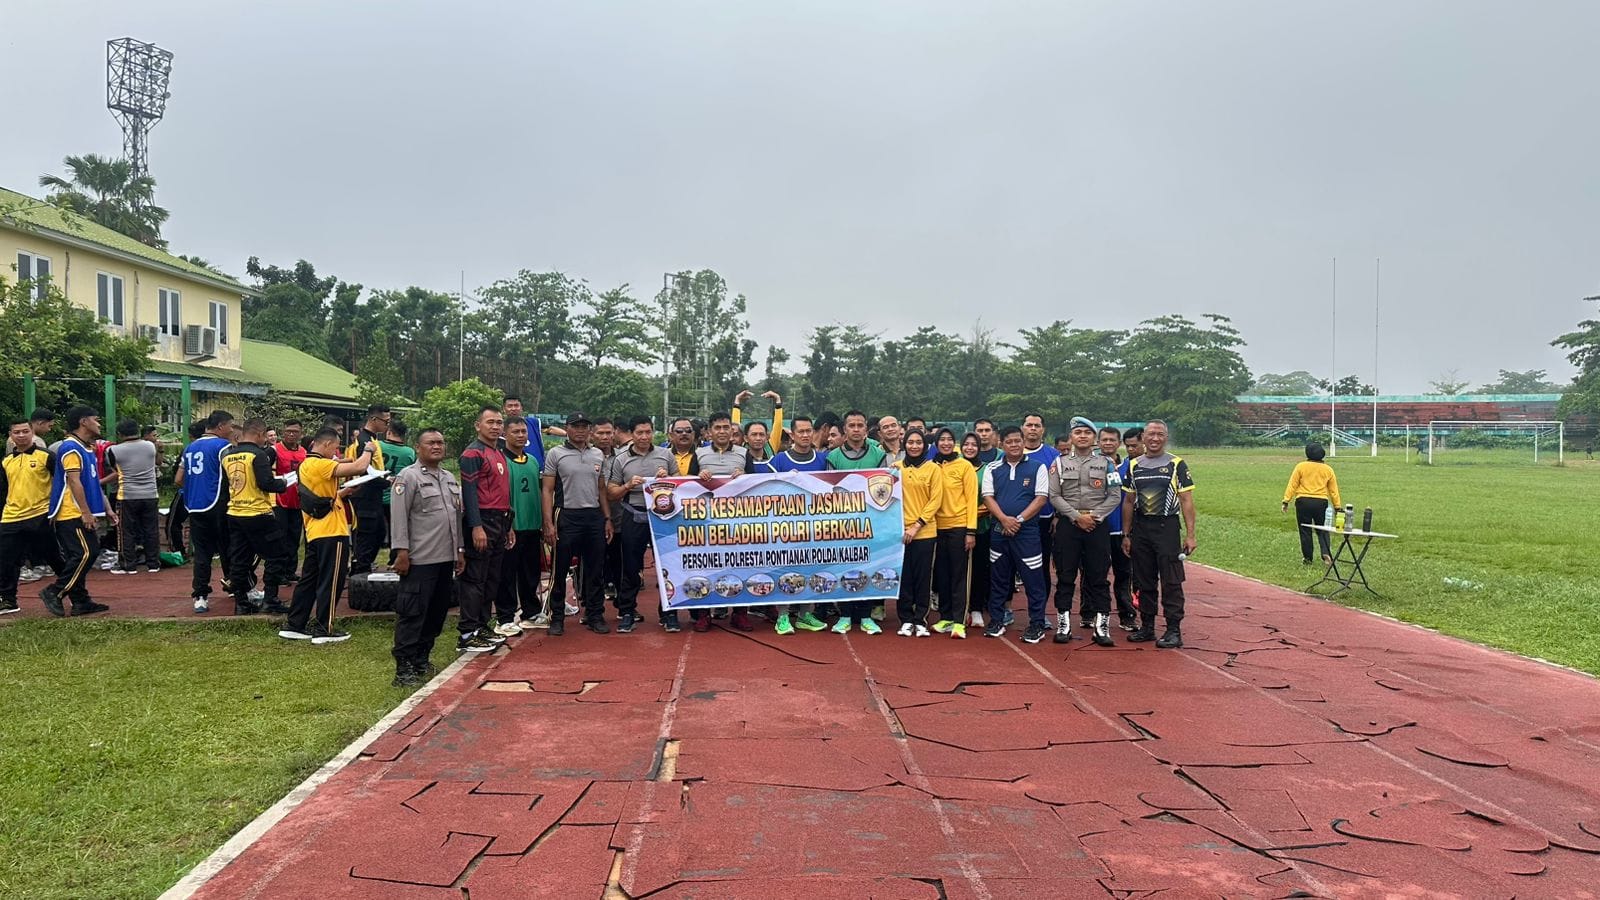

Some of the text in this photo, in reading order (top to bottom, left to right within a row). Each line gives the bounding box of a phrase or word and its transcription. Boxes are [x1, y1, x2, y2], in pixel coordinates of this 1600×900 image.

[186, 451, 204, 475] 13
[521, 478, 530, 492] 2
[682, 492, 866, 520] TES KESAMAPTAAN JASMANI
[678, 518, 873, 546] DAN BELADIRI POLRI BERKALA
[682, 546, 869, 569] PERSONEL POLRESTA PONTIANAK POLDA KALBAR
